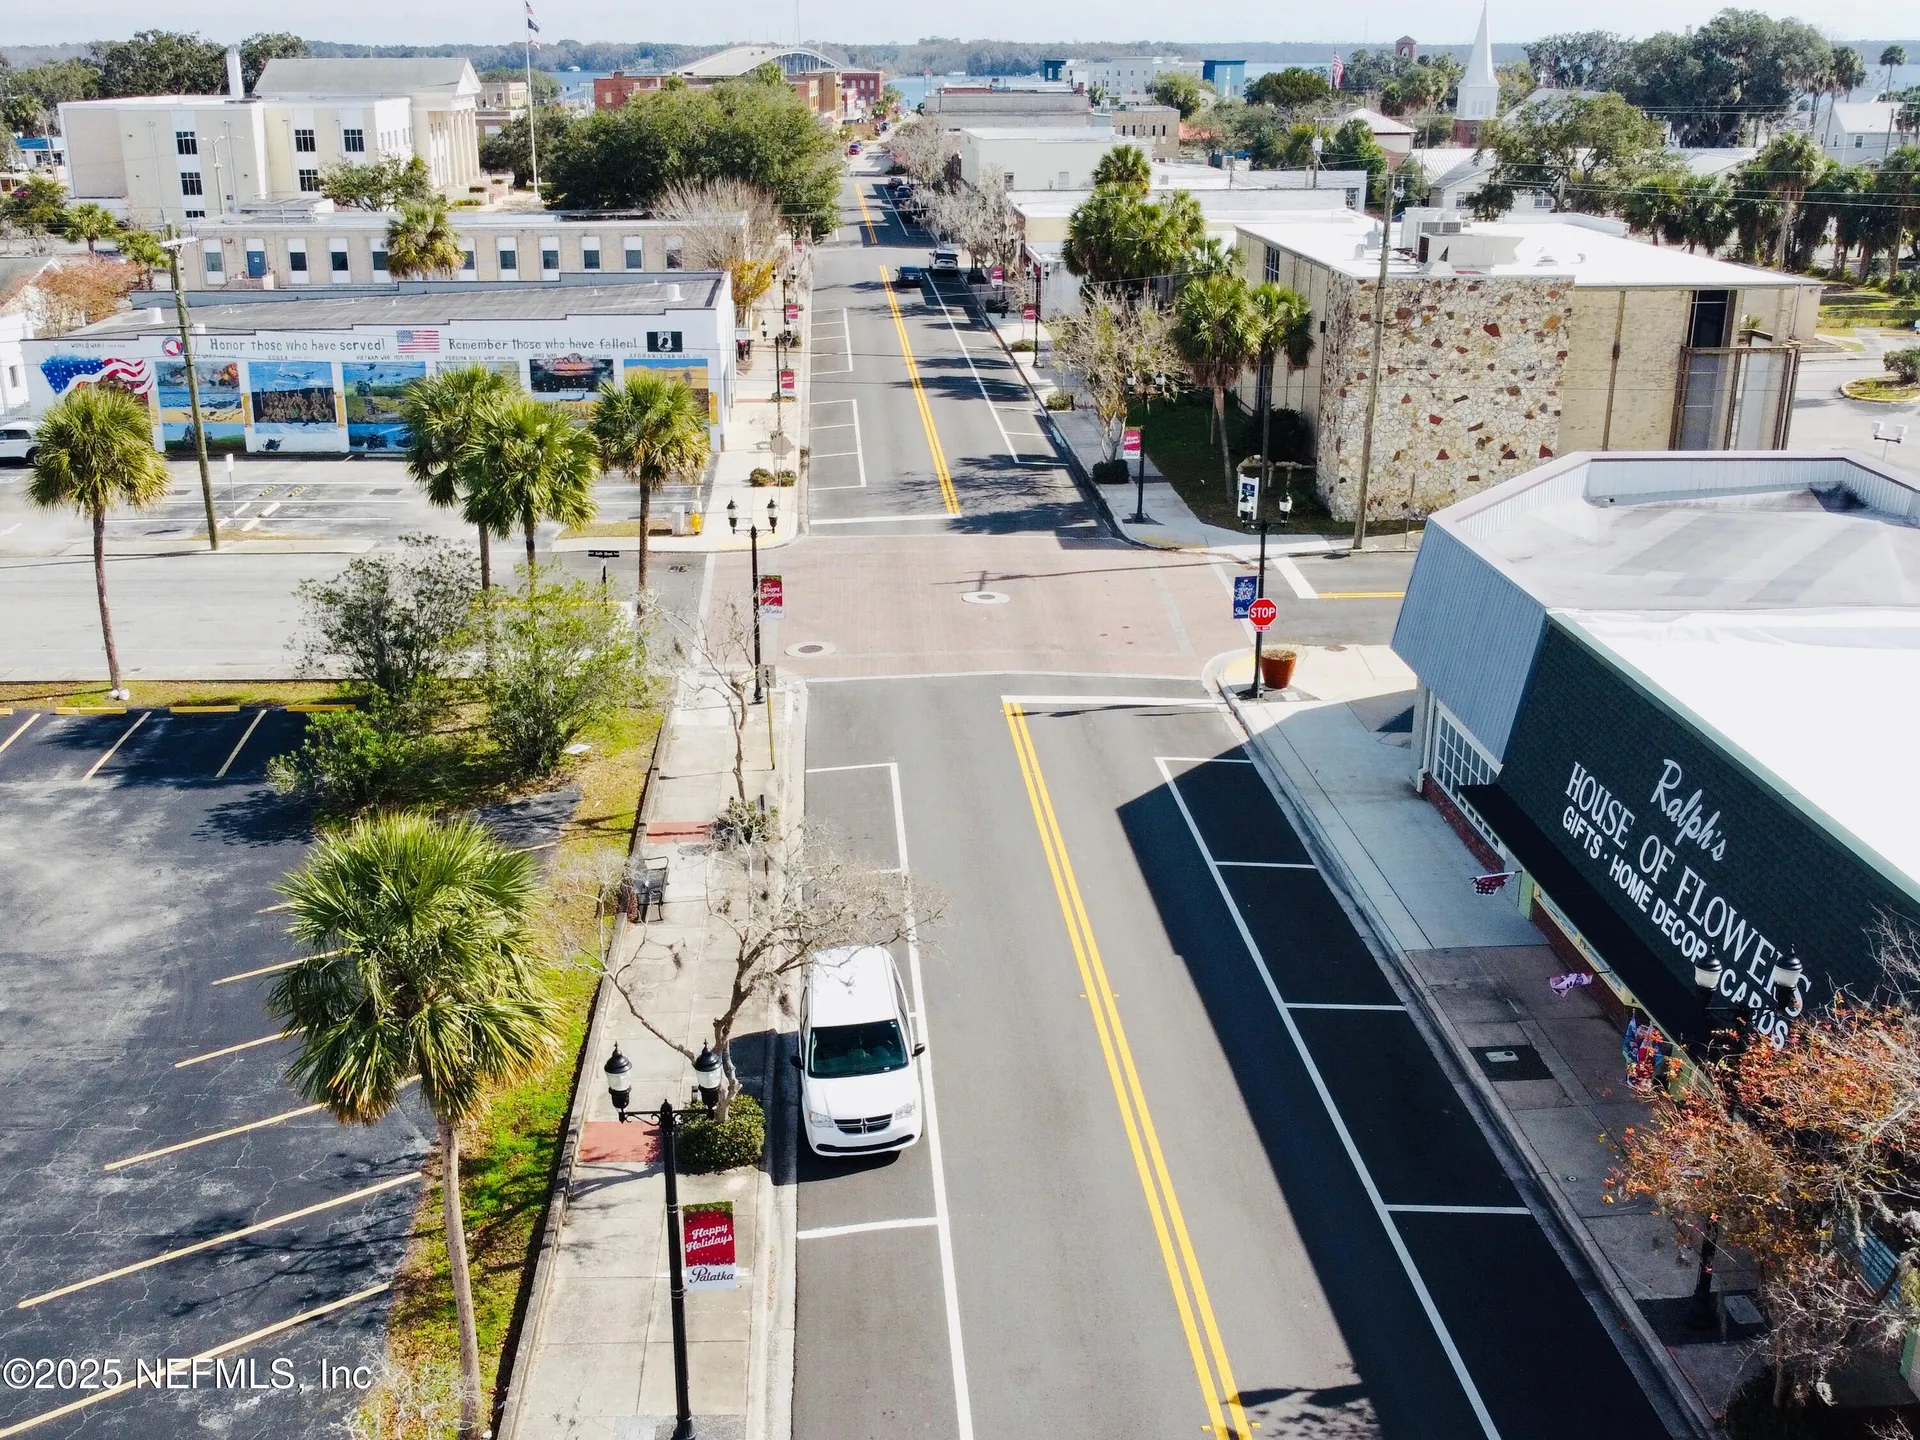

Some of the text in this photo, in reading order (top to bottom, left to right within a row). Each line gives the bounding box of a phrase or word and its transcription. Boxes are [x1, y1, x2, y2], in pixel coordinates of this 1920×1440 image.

[210, 338, 245, 351] Honor
[250, 340, 283, 351] those
[311, 338, 336, 351] have
[340, 338, 385, 351] served!
[448, 337, 637, 351] Remember those who have fallen!
[1250, 607, 1276, 618] STOP
[1650, 758, 1726, 862] Ralph's
[1565, 761, 1636, 850] HOUSE
[1639, 834, 1676, 885] OF
[1562, 805, 1604, 860] GIFTS
[1609, 853, 1654, 913] HOME
[691, 1224, 728, 1240] Happy
[685, 1234, 733, 1253] Holidays
[689, 1266, 734, 1284] Palatka
